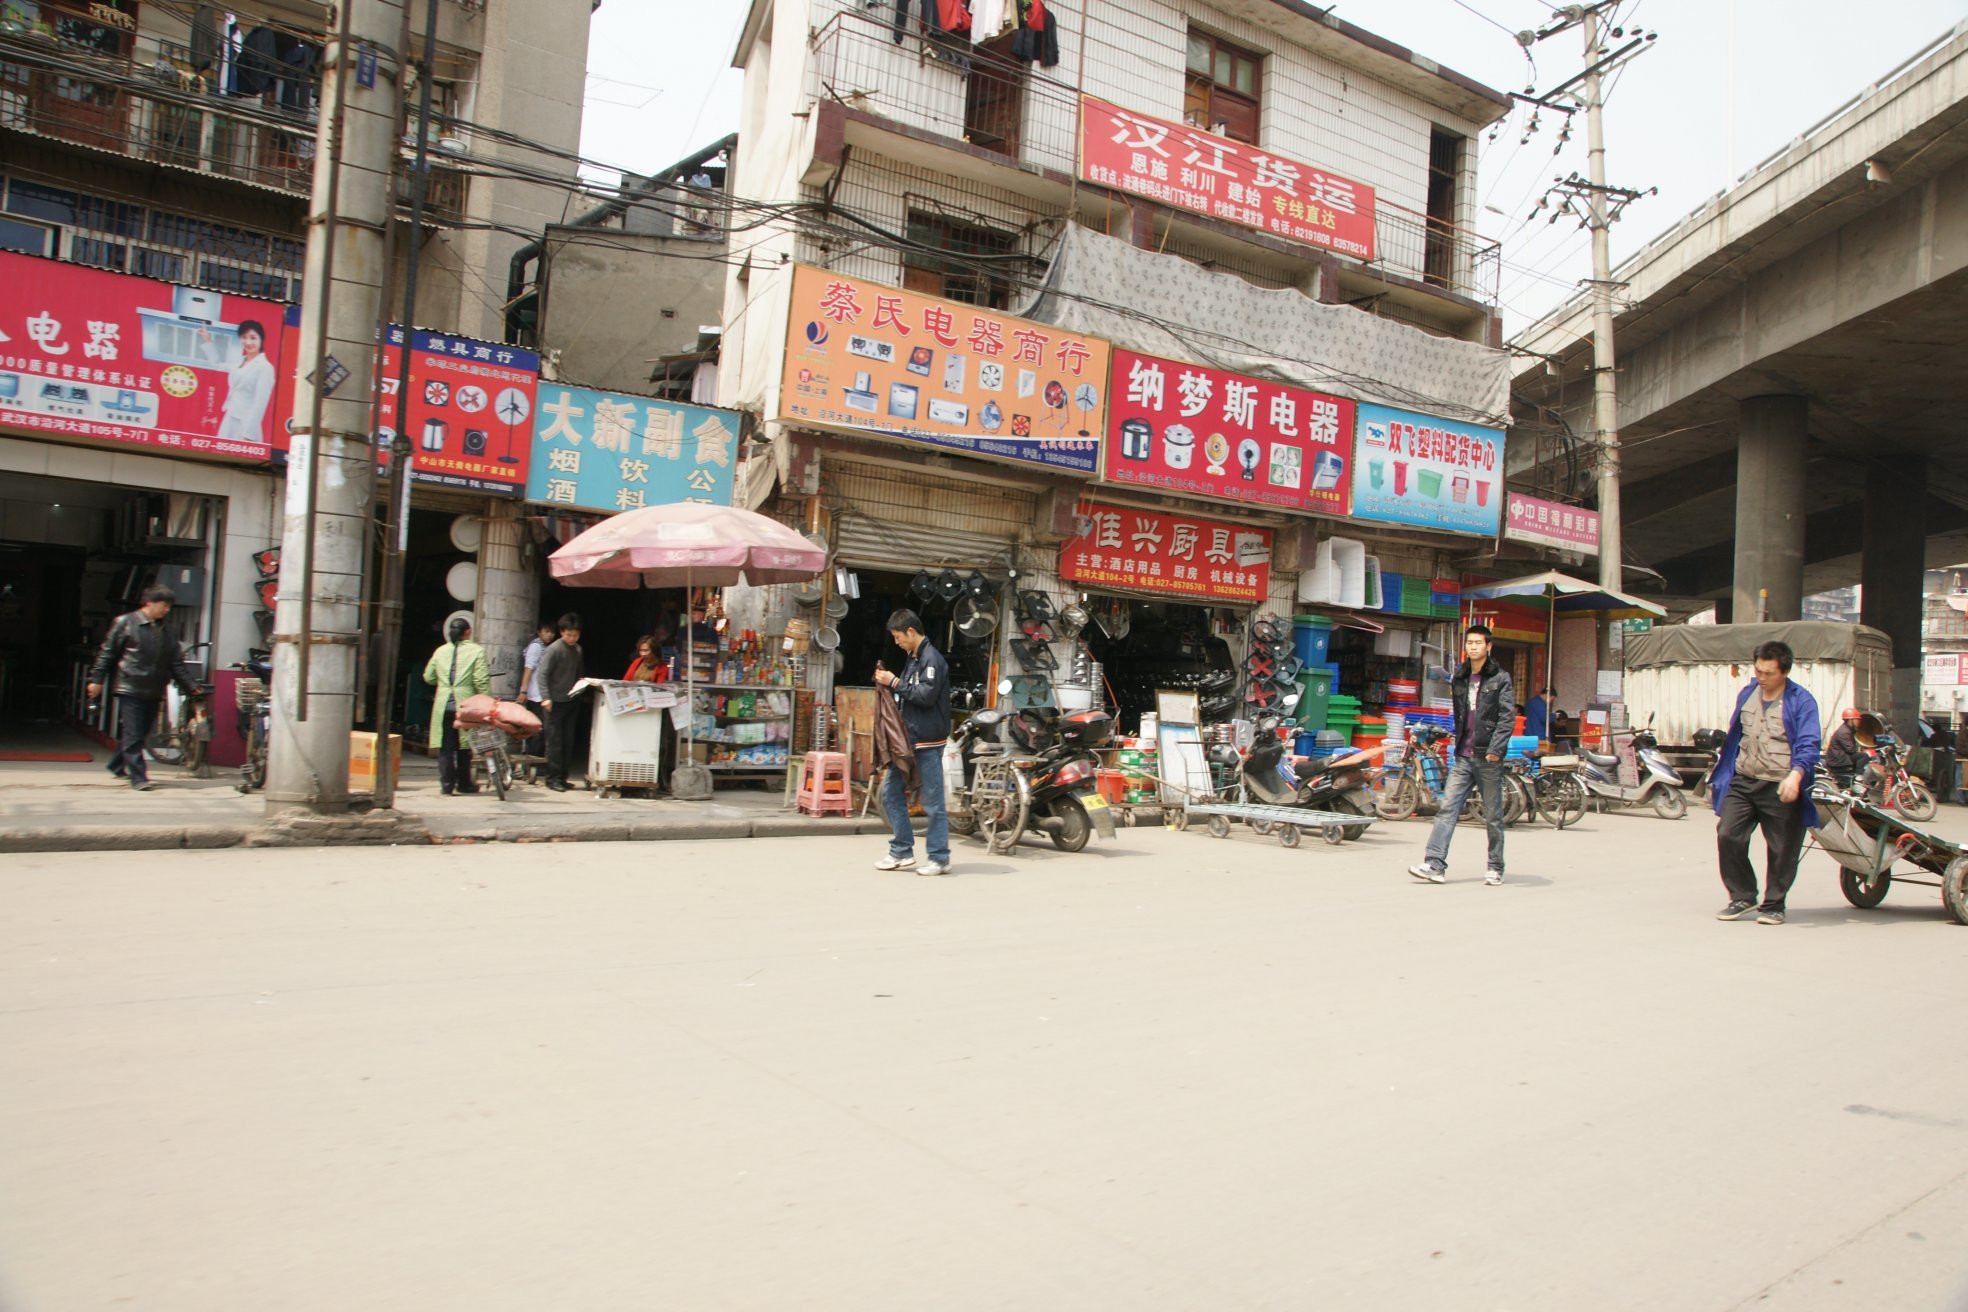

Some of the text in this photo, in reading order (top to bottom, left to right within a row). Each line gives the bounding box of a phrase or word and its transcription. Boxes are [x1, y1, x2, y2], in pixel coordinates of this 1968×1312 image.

[1109, 111, 1356, 215] 汉江货运
[1130, 152, 1336, 229] 恩施 利川 建始 专线直达
[0, 310, 121, 360] 电器
[427, 338, 514, 364] 燃具商行
[820, 280, 1092, 375] 蔡氏电器商行
[539, 391, 735, 468] 大新副食
[1127, 359, 1340, 446] 纳梦斯电器
[1388, 421, 1496, 471] 双飞塑料配货中心
[546, 448, 581, 504] 烟酒
[1093, 511, 1233, 565] 佳兴厨具
[1525, 504, 1597, 534] 中国福利彩票
[1076, 552, 1259, 587] 主营:酒店用品 厨房 机械设备
